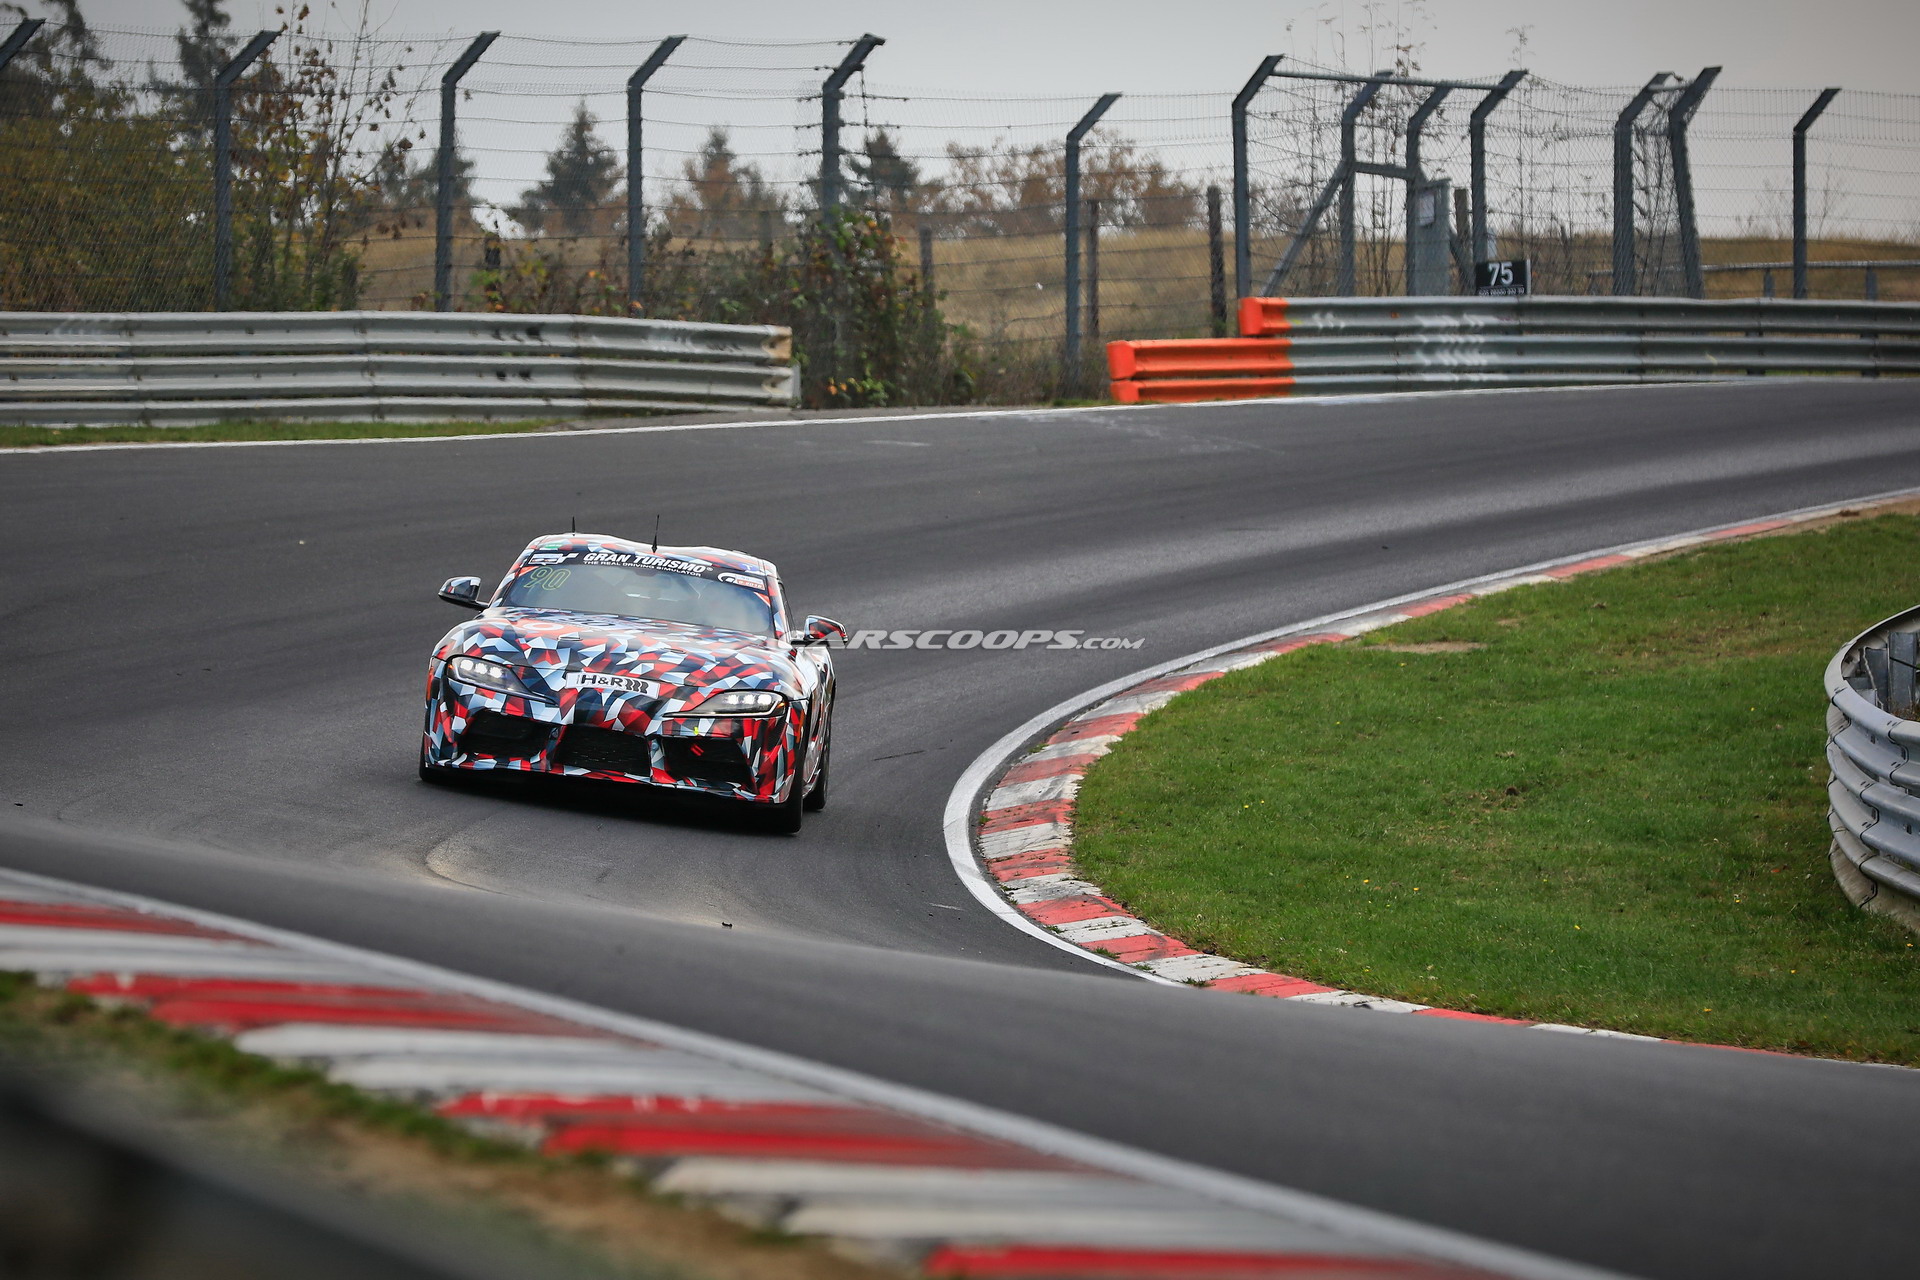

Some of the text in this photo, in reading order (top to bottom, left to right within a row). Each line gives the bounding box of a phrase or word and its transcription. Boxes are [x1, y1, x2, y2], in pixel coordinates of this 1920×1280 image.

[1488, 261, 1514, 286] 75
[583, 552, 632, 562] GRAN
[656, 565, 702, 577] SIMULATOR
[523, 566, 571, 591] 90
[581, 674, 624, 688] H&R
